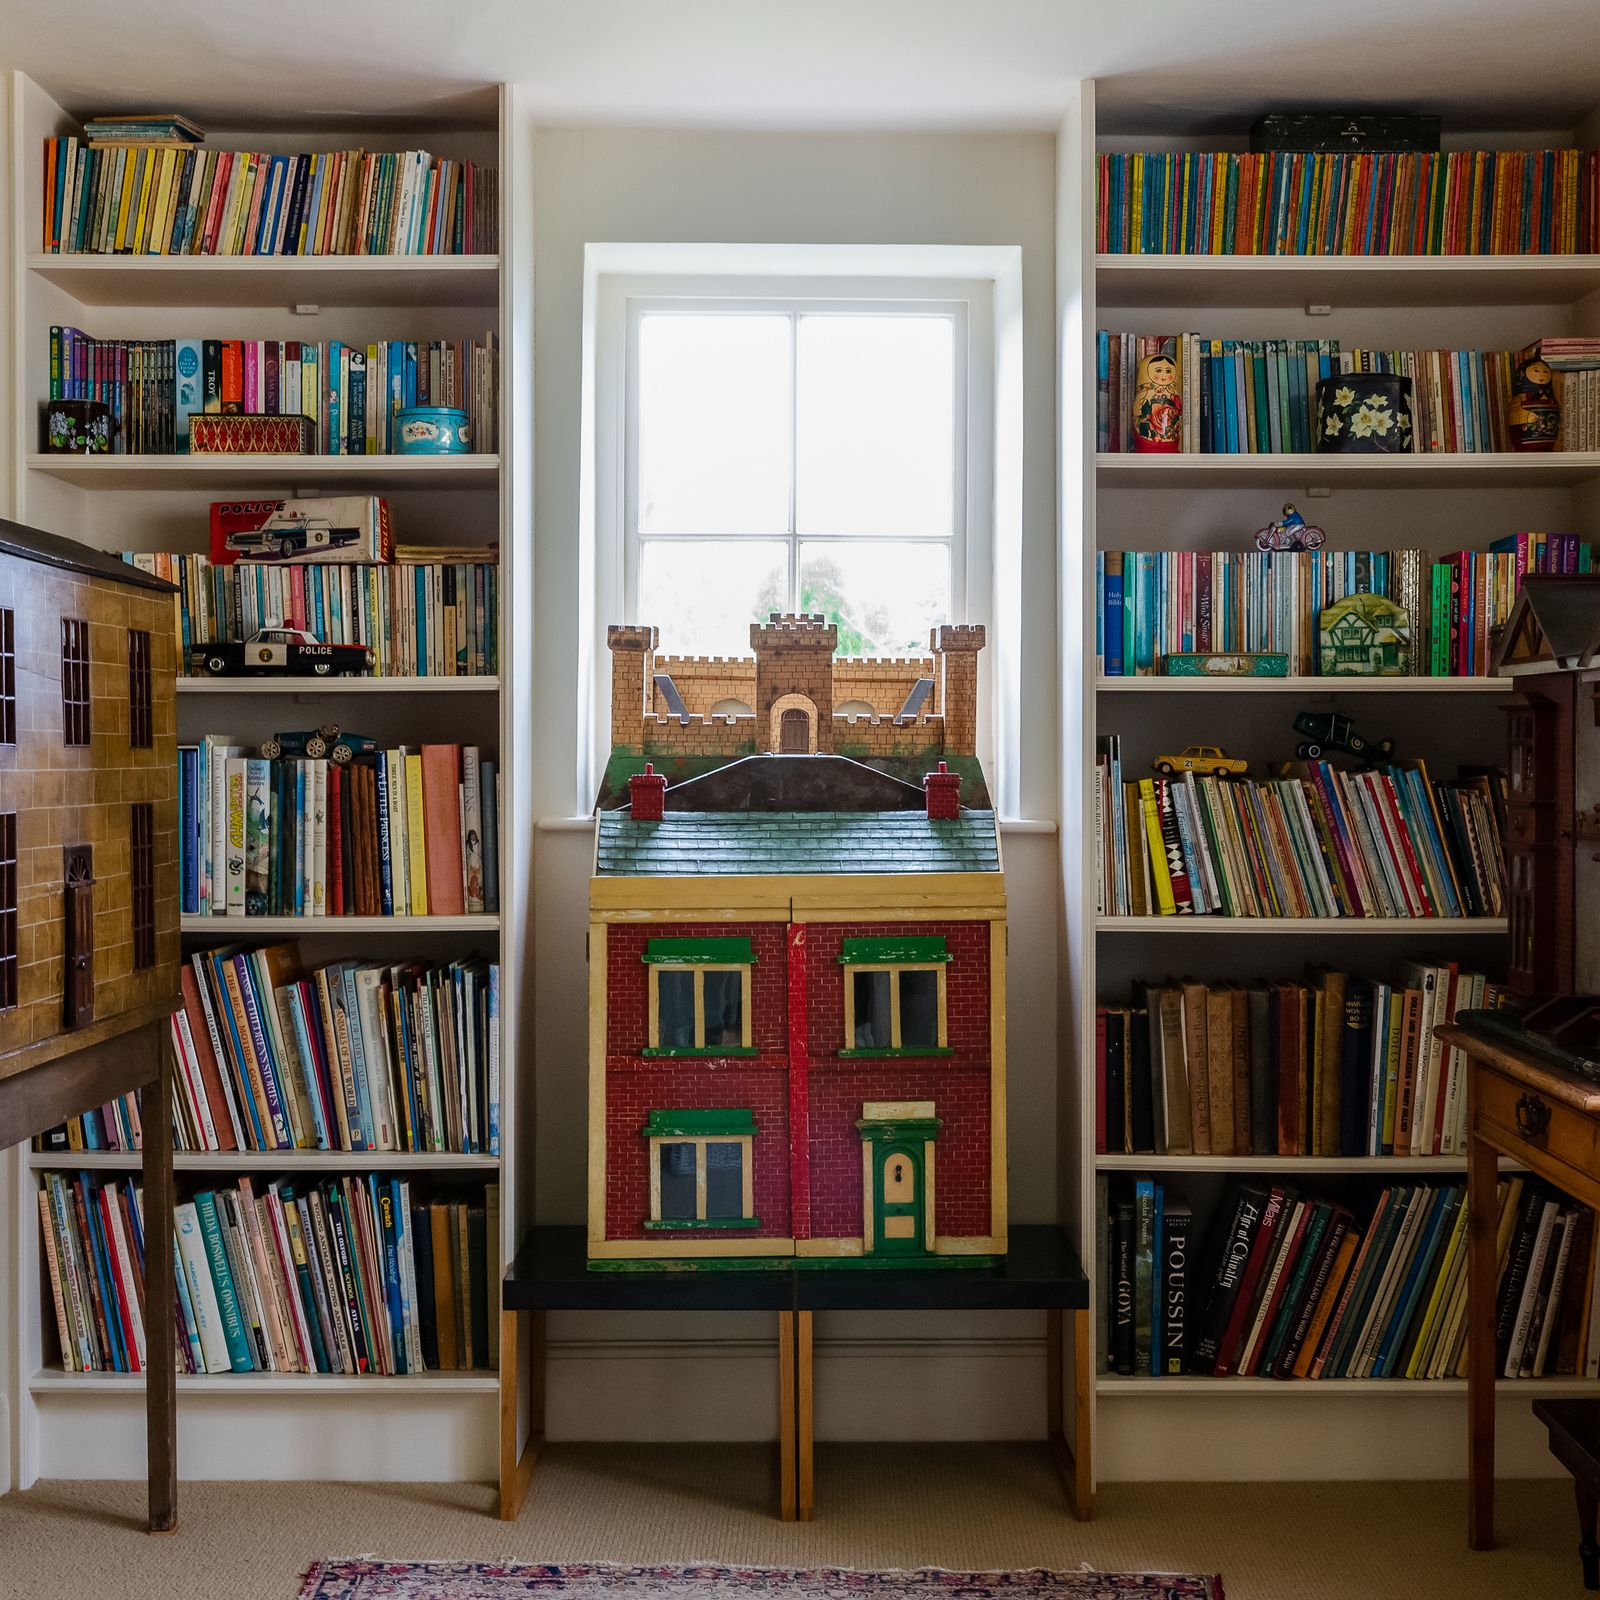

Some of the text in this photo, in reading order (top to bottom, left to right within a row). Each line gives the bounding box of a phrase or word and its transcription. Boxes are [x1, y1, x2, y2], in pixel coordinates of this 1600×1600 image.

[220, 503, 287, 515] POLICE
[382, 505, 390, 558] POLICE
[1568, 552, 1576, 571] Dare
[1108, 591, 1122, 599] Holy
[1201, 594, 1209, 618] Wind
[1201, 618, 1209, 645] Singer
[299, 646, 333, 655] POLICE
[1185, 760, 1194, 768] 21
[379, 782, 388, 815] LITTLE
[464, 756, 474, 813] QUEENS
[230, 810, 243, 849] WHY
[381, 817, 390, 861] PRINCESS
[1439, 972, 1447, 989] THE
[316, 972, 328, 1024] RONALD JESSUP
[347, 978, 358, 1021] TREASURY
[1436, 991, 1446, 1023] WORLD
[207, 1013, 220, 1055] HIAWATHA
[226, 972, 261, 1101] THE REAL MOTHER GOOSE
[336, 1009, 347, 1045] ANIMALS
[247, 1001, 269, 1063] CHILDREN'S
[261, 1064, 278, 1106] STORIES
[325, 1028, 333, 1046] AGE
[330, 1070, 338, 1090] AGE
[353, 1036, 363, 1061] FAIRY
[1390, 1028, 1400, 1064] DOLLS
[342, 1059, 351, 1075] THE
[356, 1064, 366, 1089] TALES
[1400, 997, 1418, 1132] DOLLS AND DOLLMAKERS MARY HILLIER
[344, 1077, 355, 1106] WORLD
[39, 1199, 50, 1218] THE
[53, 1180, 66, 1231] Richard Scarry's
[1238, 1203, 1260, 1228] Age
[1262, 1195, 1283, 1227] Millais
[42, 1219, 54, 1244] PIED
[1120, 1240, 1128, 1252] The
[1541, 1222, 1551, 1242] ROYAL
[46, 1246, 57, 1272] PIPER
[201, 1202, 240, 1337] HILDA BOSWELL'S OMNIBUS
[314, 1202, 347, 1350] YOUNG ANIMALS YOUNG ANIMALS
[1120, 1254, 1128, 1269] World
[1219, 1242, 1250, 1288] Chivalry
[1532, 1244, 1547, 1278] COLLEGE
[336, 1222, 359, 1331] THE OXFORD SCHOOL ATLAS
[1167, 1235, 1185, 1348] POUSSIN
[1256, 1241, 1290, 1323] THOMAS HART BENTON
[1496, 1232, 1532, 1339] MICHELANGELO
[1528, 1285, 1538, 1298] ART
[51, 1289, 66, 1336] HAMELIN
[1118, 1280, 1131, 1325] GOYA
[1284, 1224, 1345, 1368] THE PRE-RAPHAELITES AND THEIR WORLD FOLIO
[1516, 1311, 1531, 1345] FRAYLING
[277, 1343, 285, 1360] TIGER
